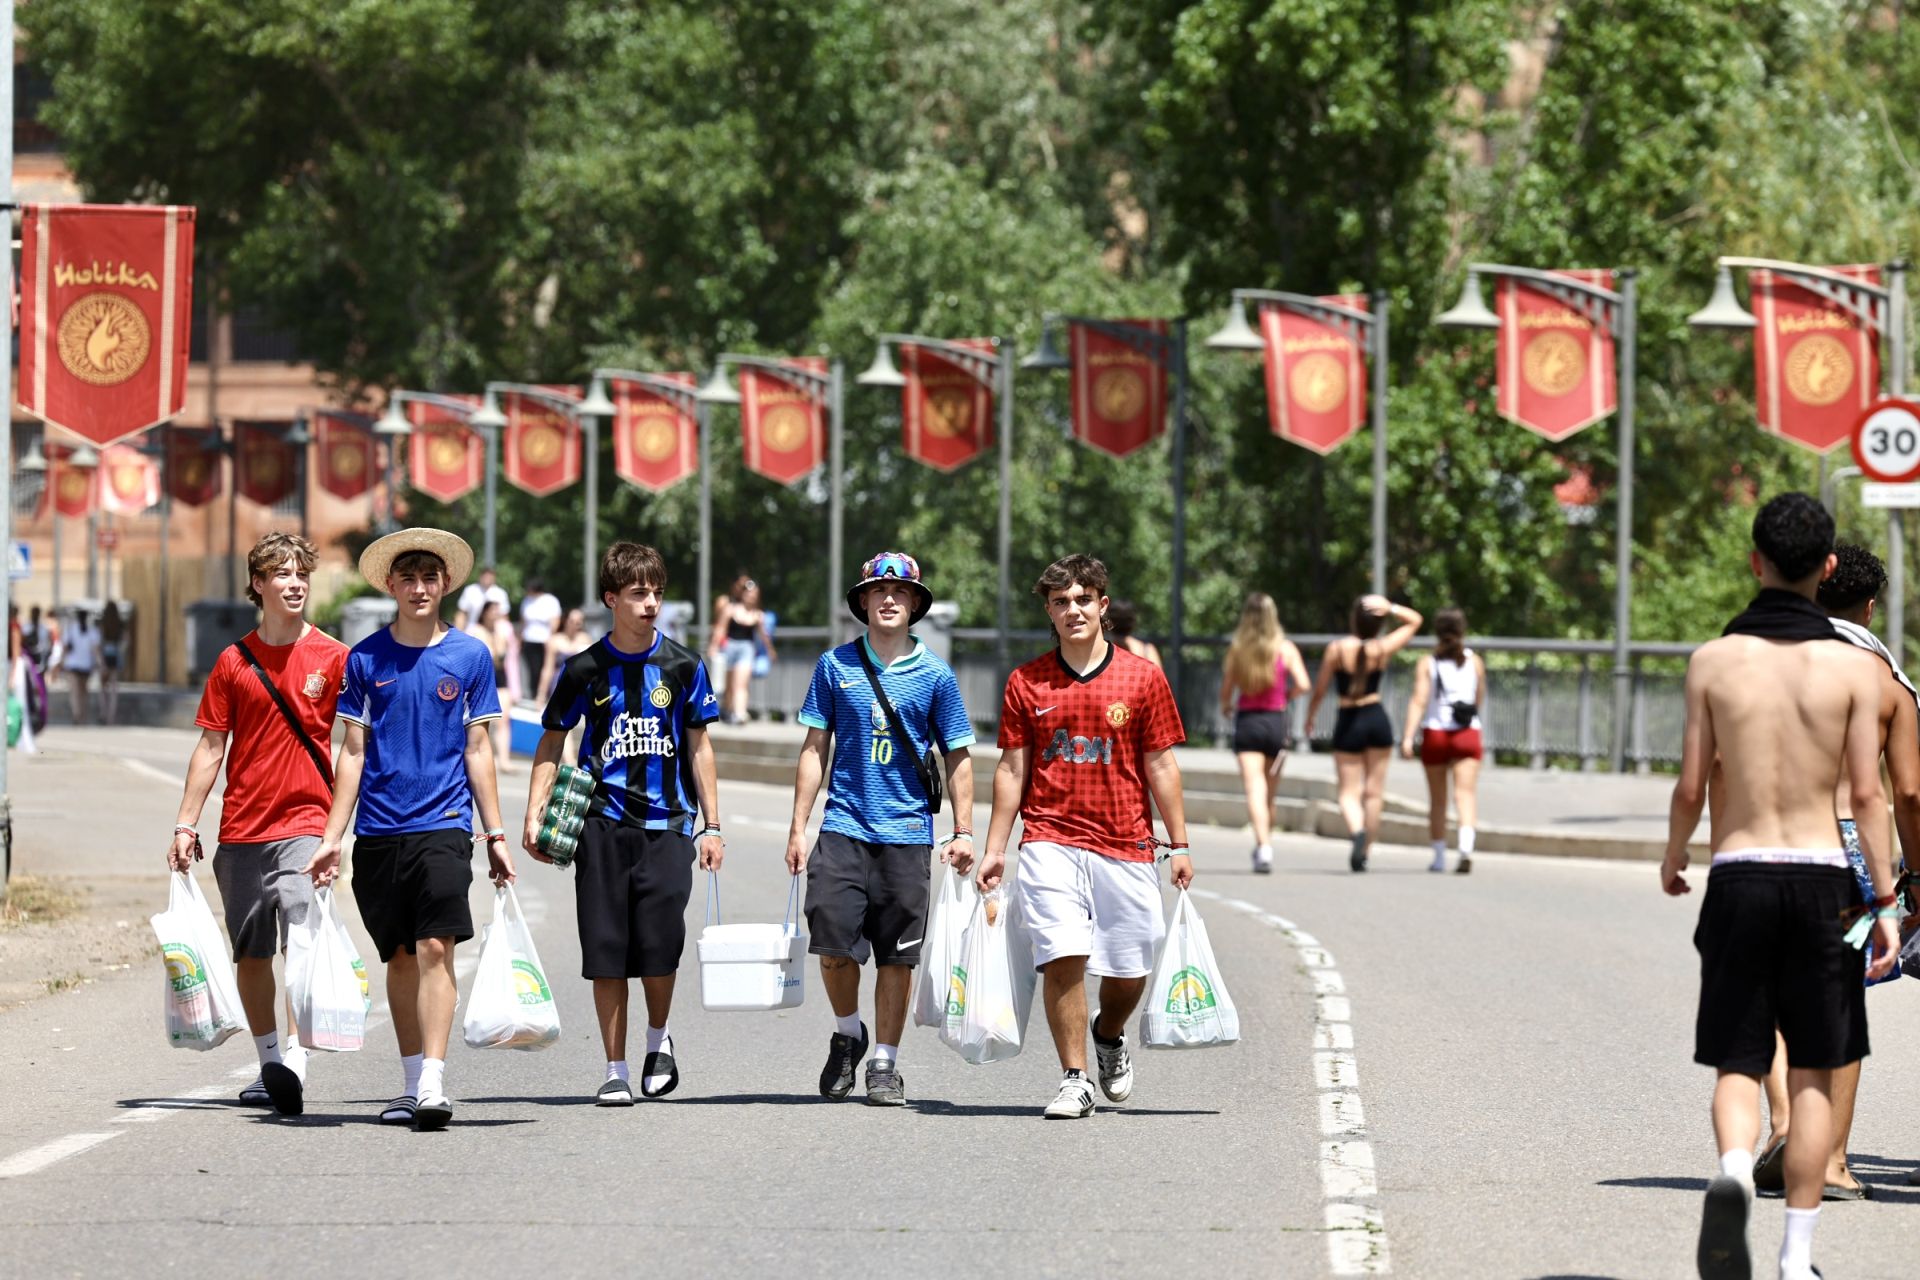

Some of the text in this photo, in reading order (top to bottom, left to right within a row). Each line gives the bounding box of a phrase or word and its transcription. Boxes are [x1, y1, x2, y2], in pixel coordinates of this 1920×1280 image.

[53, 260, 159, 291] Holika
[1871, 427, 1916, 455] 30
[611, 711, 660, 739] Cruz
[871, 738, 893, 765] 10
